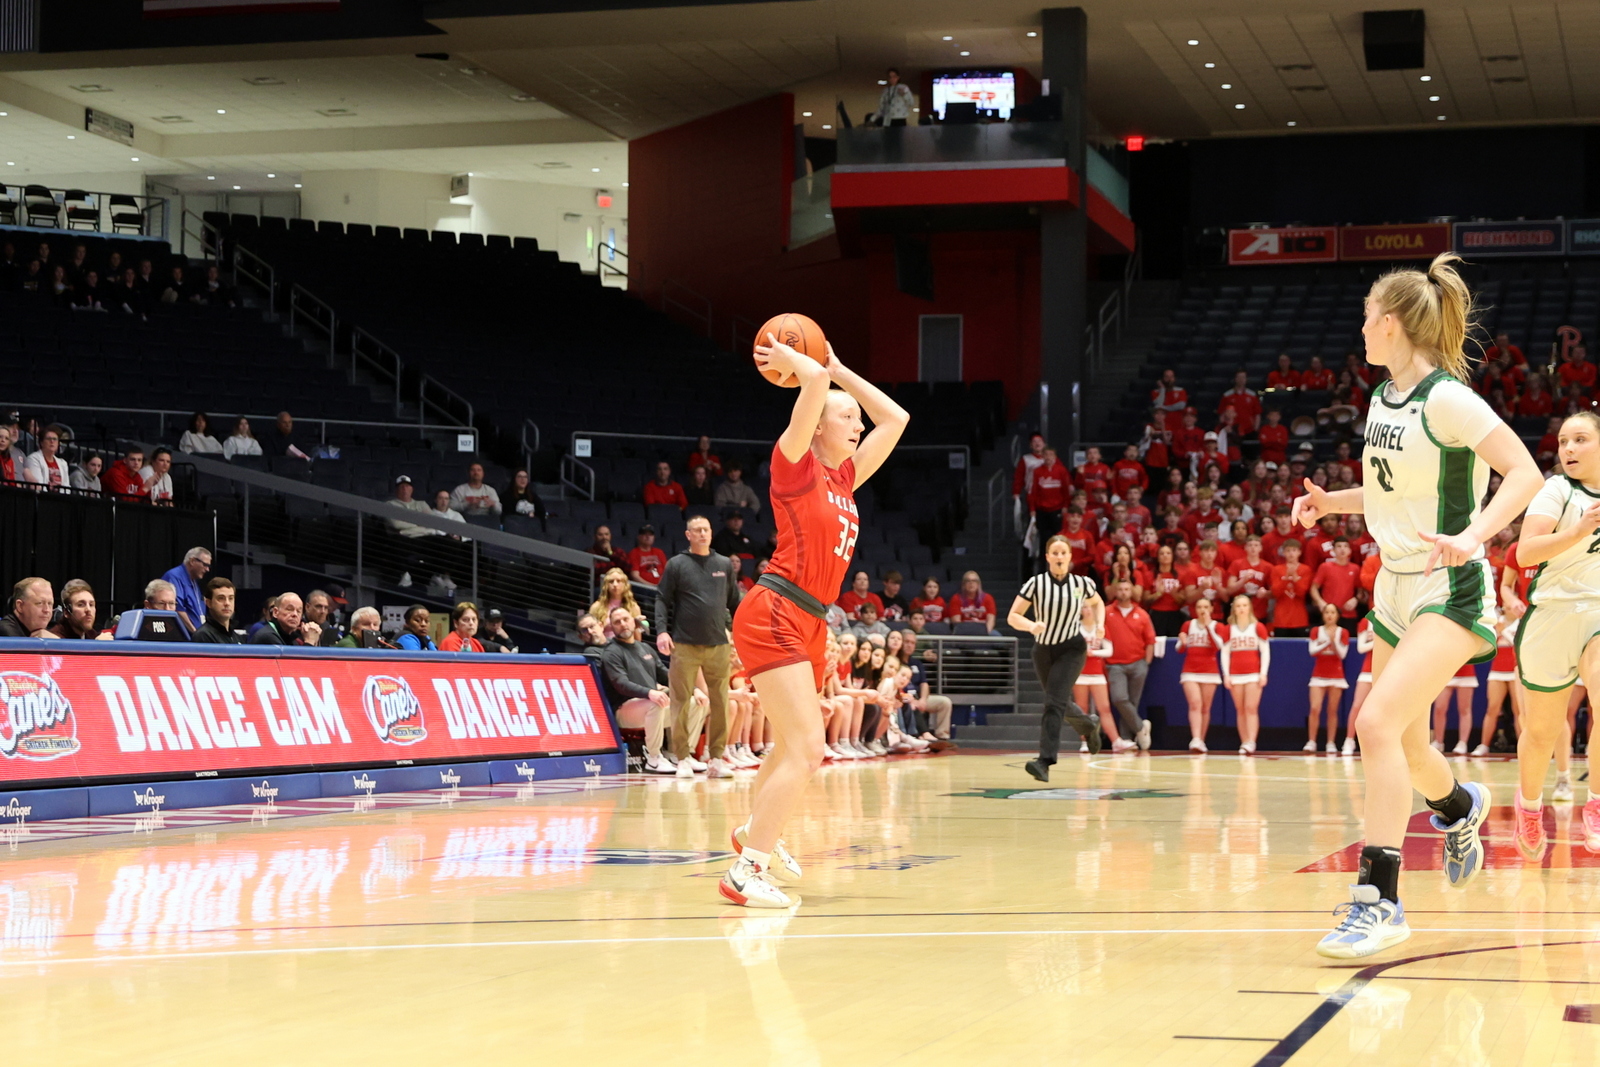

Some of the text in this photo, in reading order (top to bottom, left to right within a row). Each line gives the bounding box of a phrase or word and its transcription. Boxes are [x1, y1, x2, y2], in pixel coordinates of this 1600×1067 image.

[1365, 234, 1424, 250] LOYOLA
[1462, 230, 1555, 247] RICHMOND
[1365, 421, 1406, 451] AUREL
[833, 514, 859, 562] 32
[152, 621, 166, 633] POSS
[96, 675, 352, 752] DANCE CAM
[431, 678, 601, 739] DANCE CAM
[143, 787, 165, 811] Kroger
[260, 780, 279, 803] Kroger
[6, 797, 32, 823] Kroger
